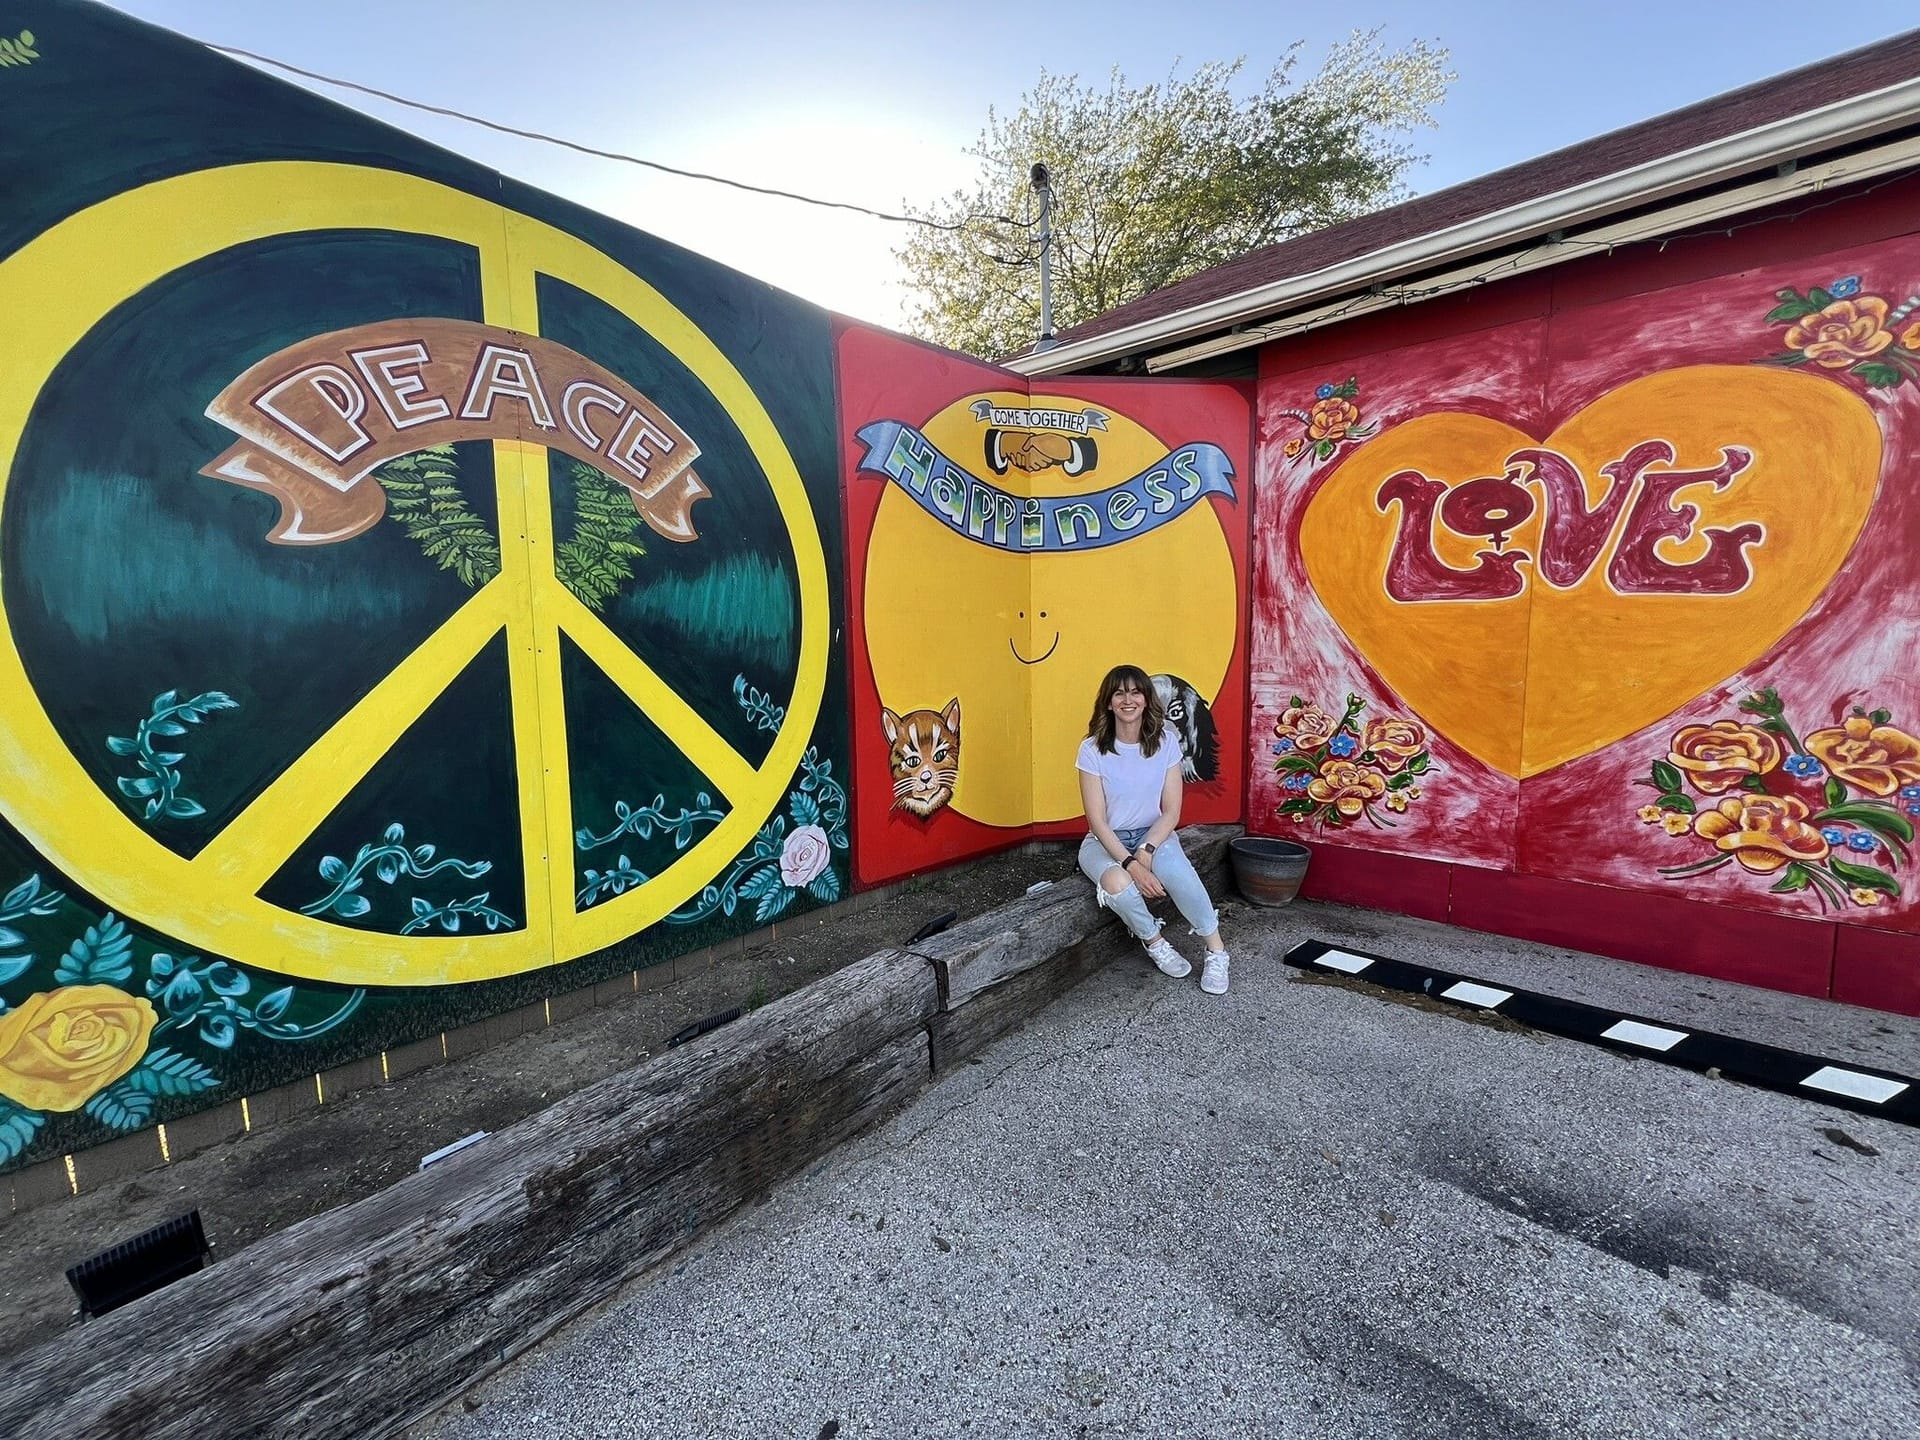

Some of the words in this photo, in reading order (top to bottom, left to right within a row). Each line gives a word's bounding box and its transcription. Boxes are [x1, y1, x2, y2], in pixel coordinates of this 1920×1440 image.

[250, 339, 678, 482] PEACE
[994, 410, 1021, 425] COME
[1024, 411, 1085, 431] TOGETHER
[884, 426, 1202, 547] Happiness
[1376, 439, 1767, 603] LOVE
